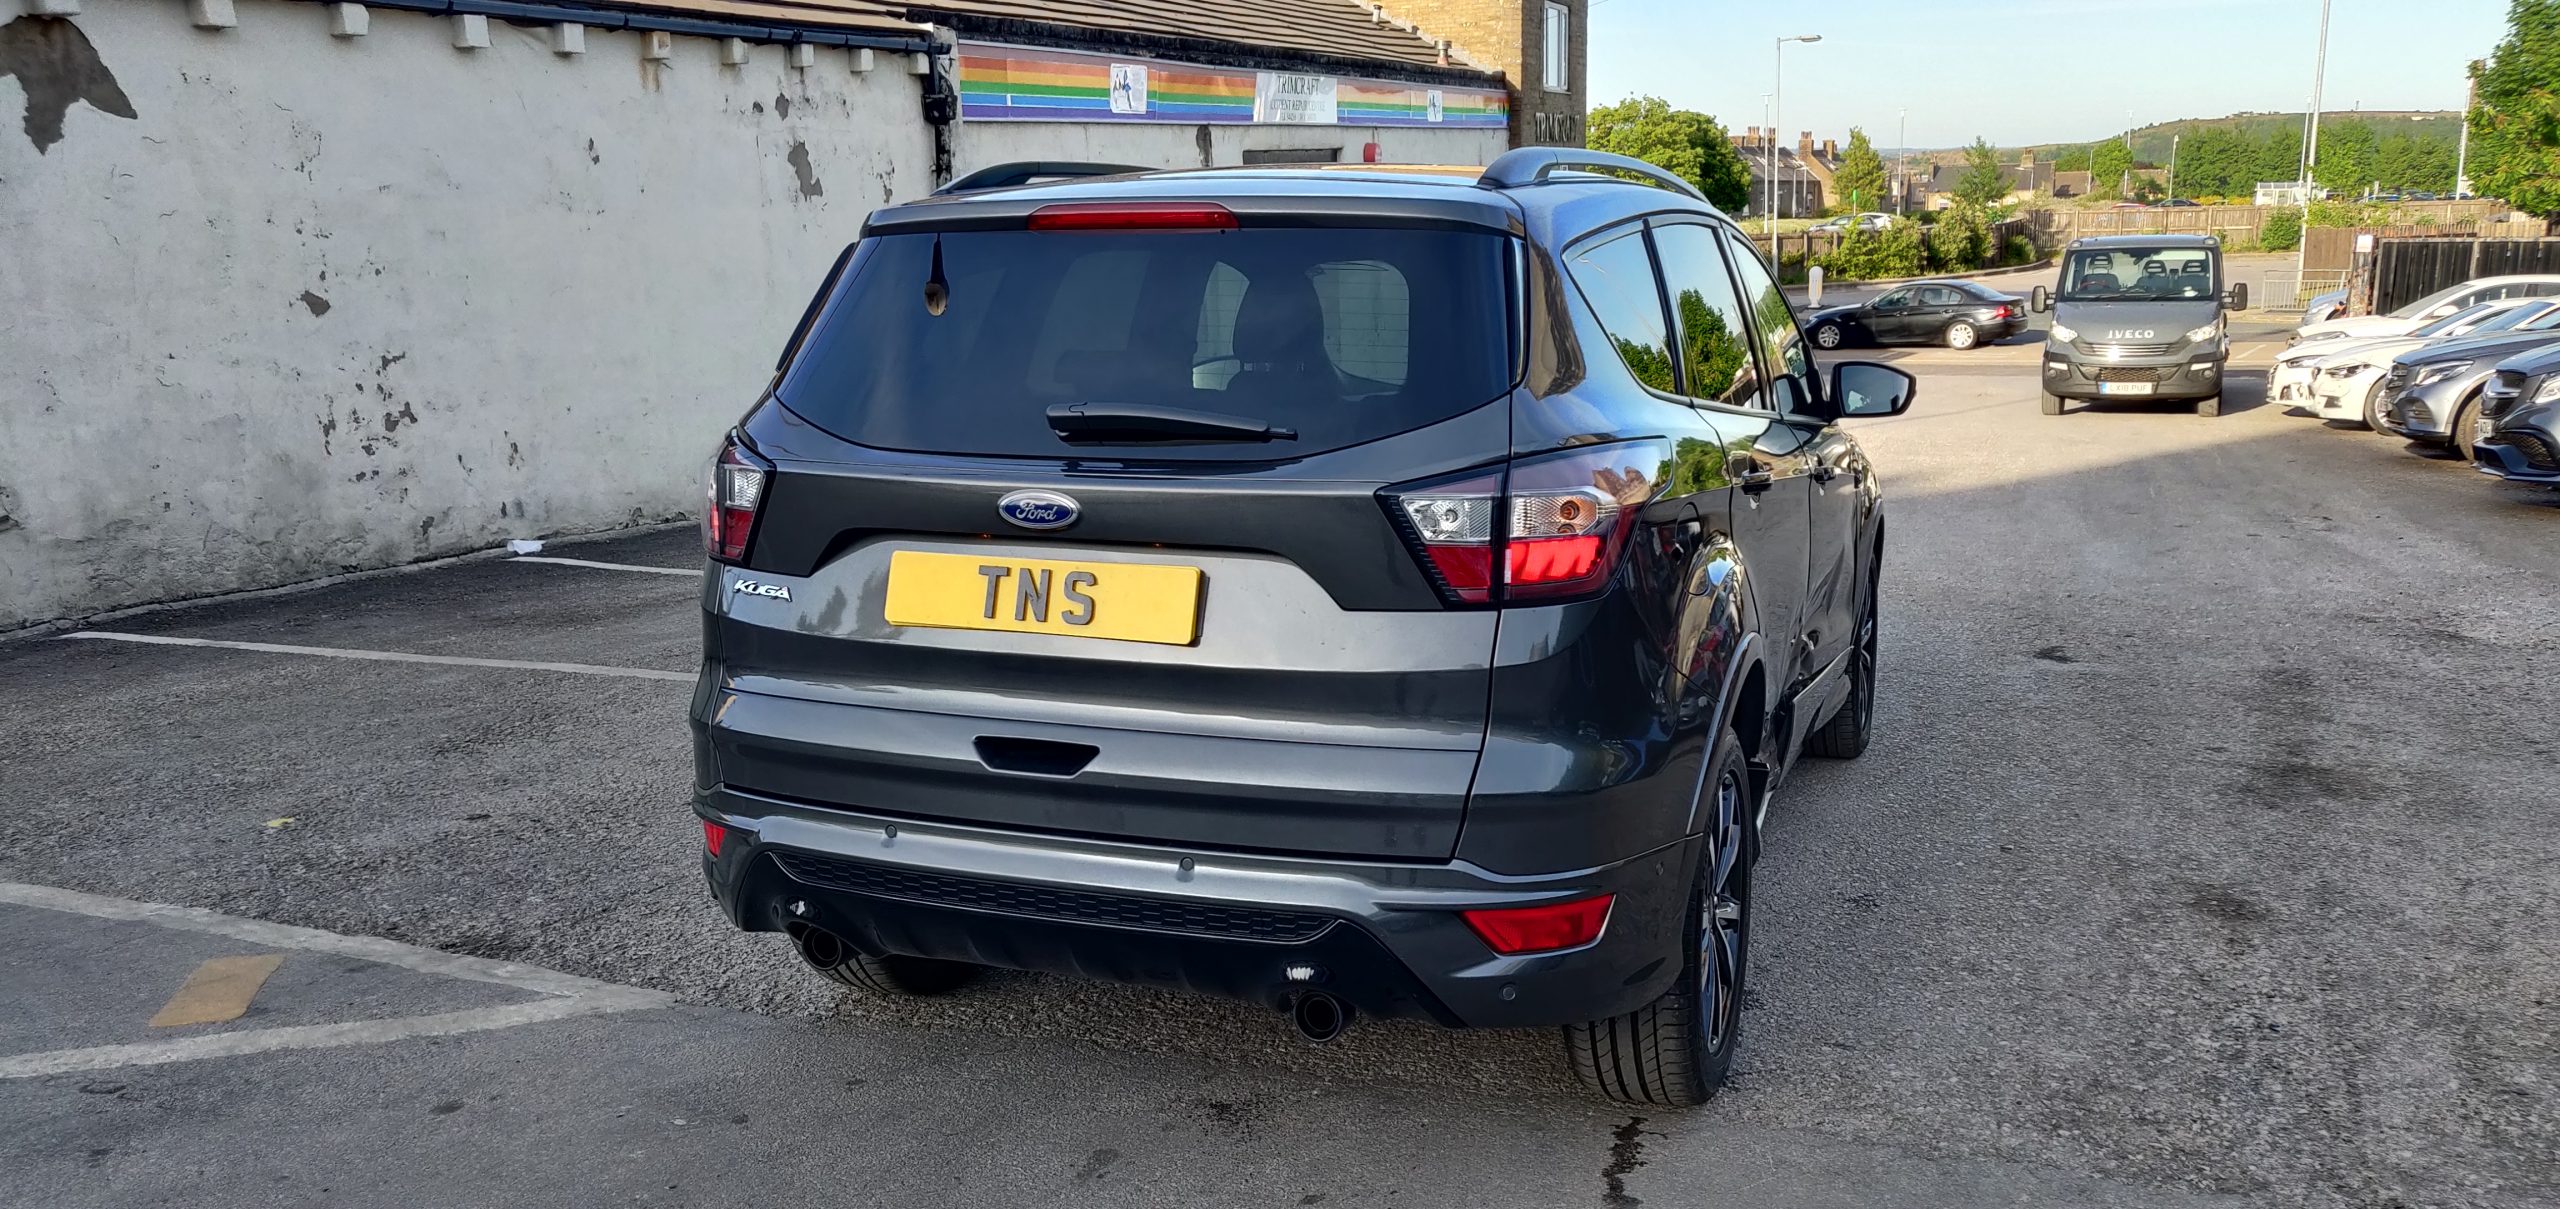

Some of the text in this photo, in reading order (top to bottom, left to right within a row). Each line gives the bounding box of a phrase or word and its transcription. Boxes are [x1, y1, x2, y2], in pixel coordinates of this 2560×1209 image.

[1277, 75, 1320, 95] TRIMCRAFT
[2107, 329, 2155, 339] IVECO
[1016, 500, 1058, 520] Ford
[733, 579, 792, 601] KUGA
[978, 565, 1098, 626] TNS
